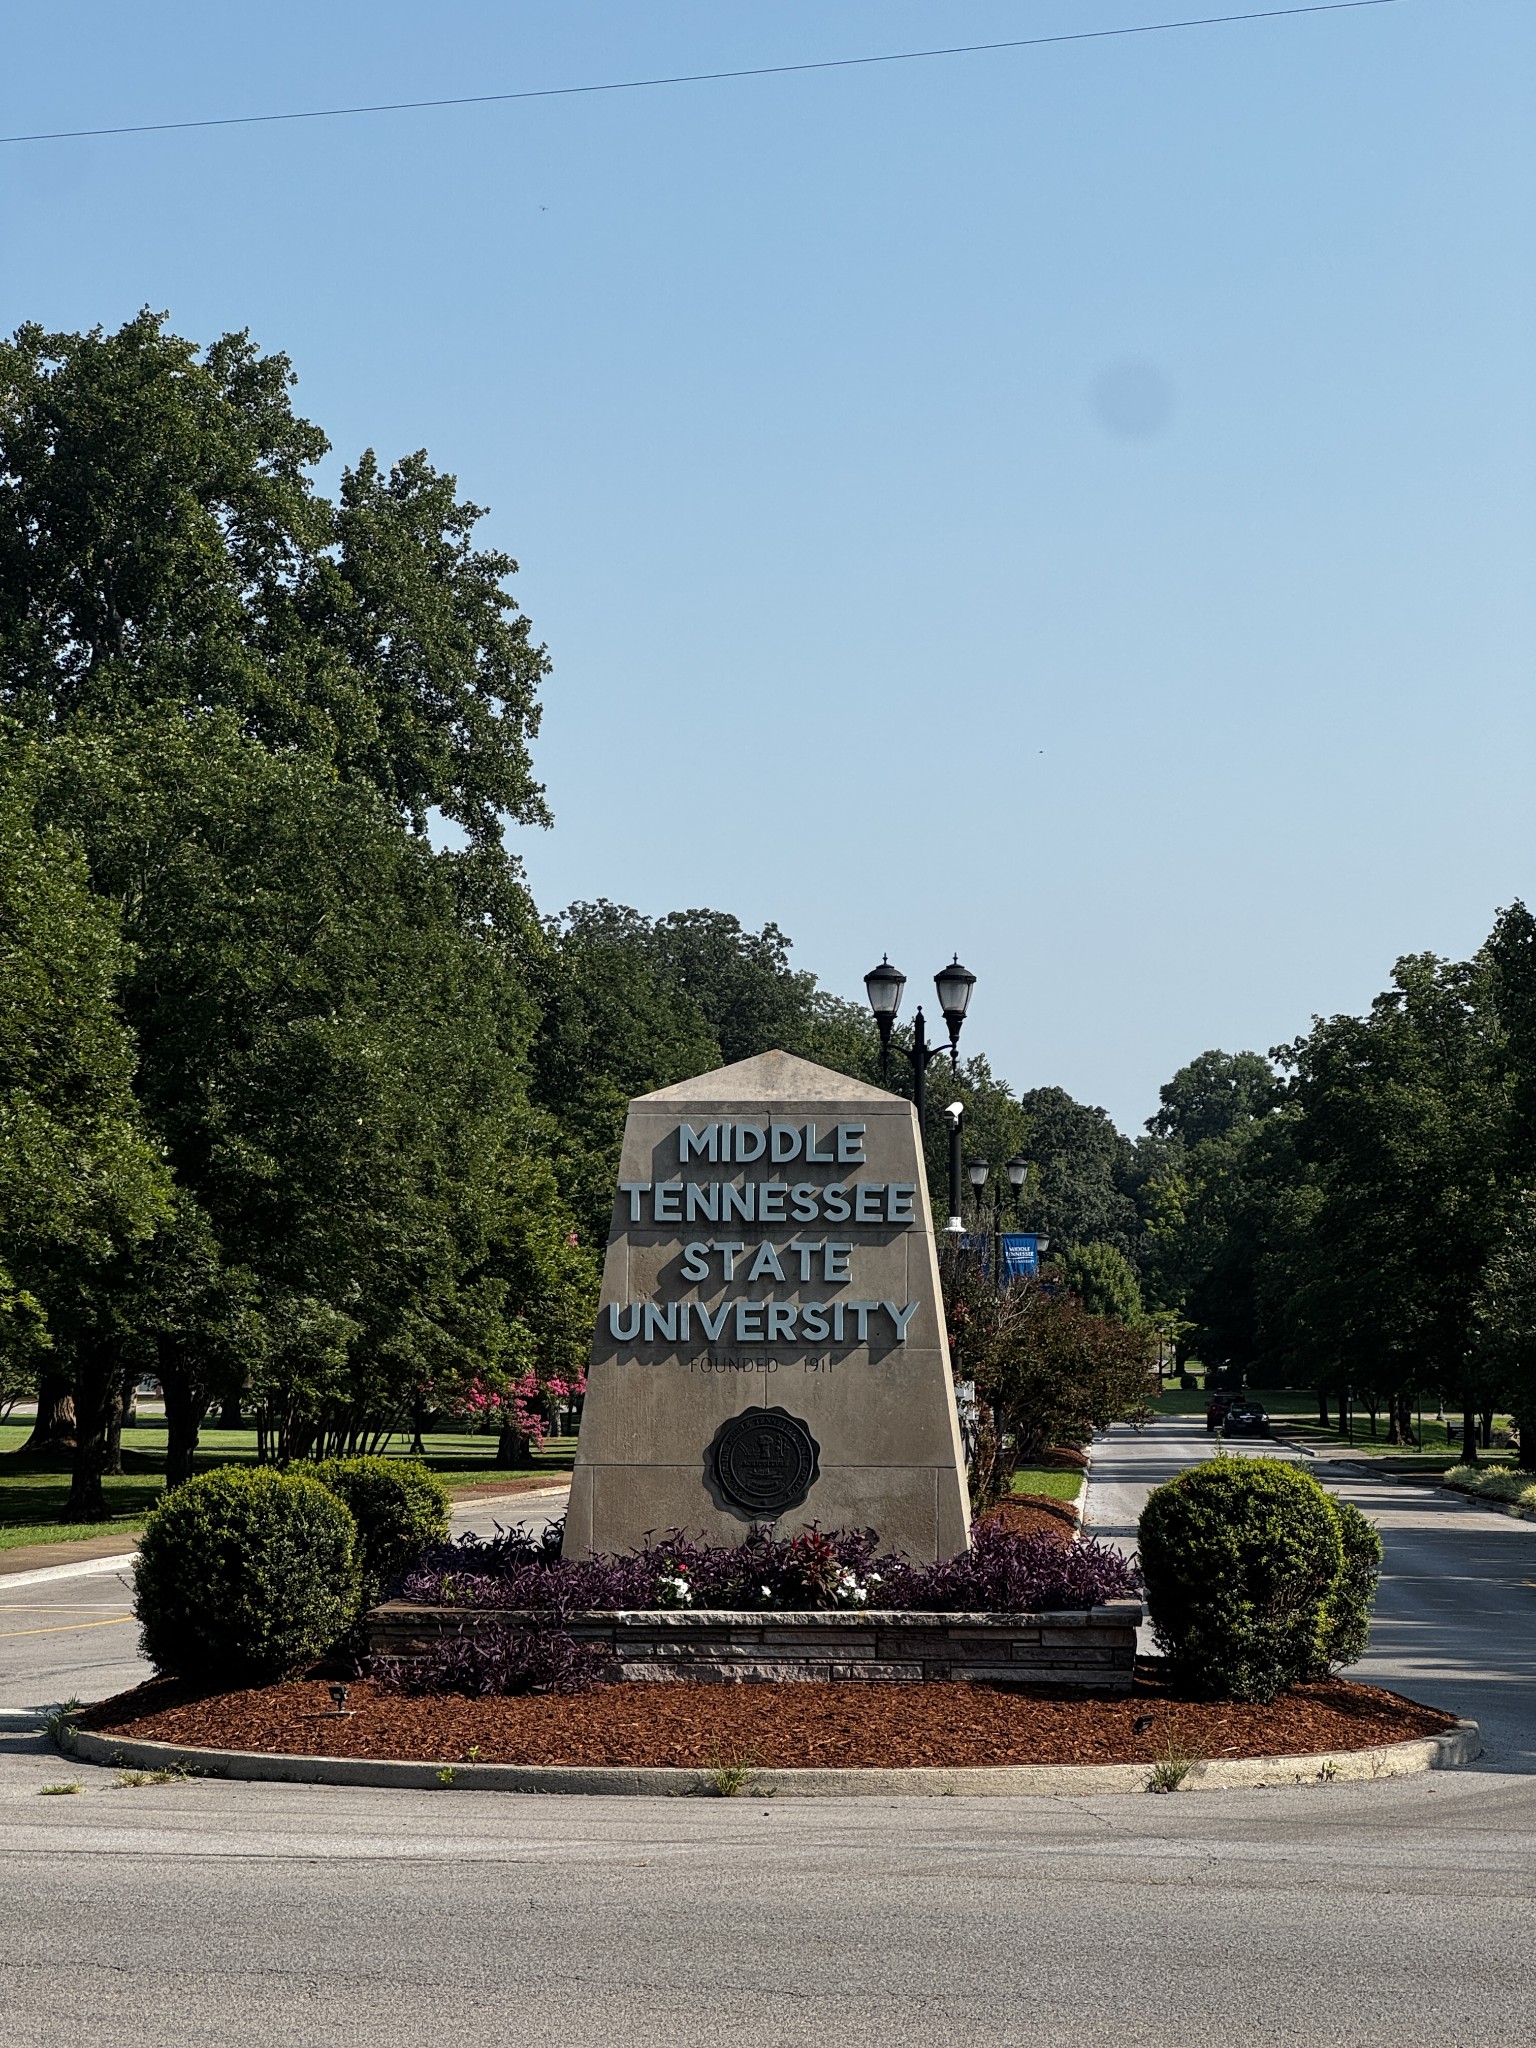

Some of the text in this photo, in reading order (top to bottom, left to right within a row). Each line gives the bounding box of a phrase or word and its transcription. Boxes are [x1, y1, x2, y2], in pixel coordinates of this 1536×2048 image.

[679, 1123, 866, 1163] MIDDLE
[620, 1182, 916, 1223] TENNESSEE
[680, 1241, 853, 1282] STATE
[609, 1301, 920, 1342] UNIVERSITY
[690, 1357, 833, 1373] FOUNDED 1911
